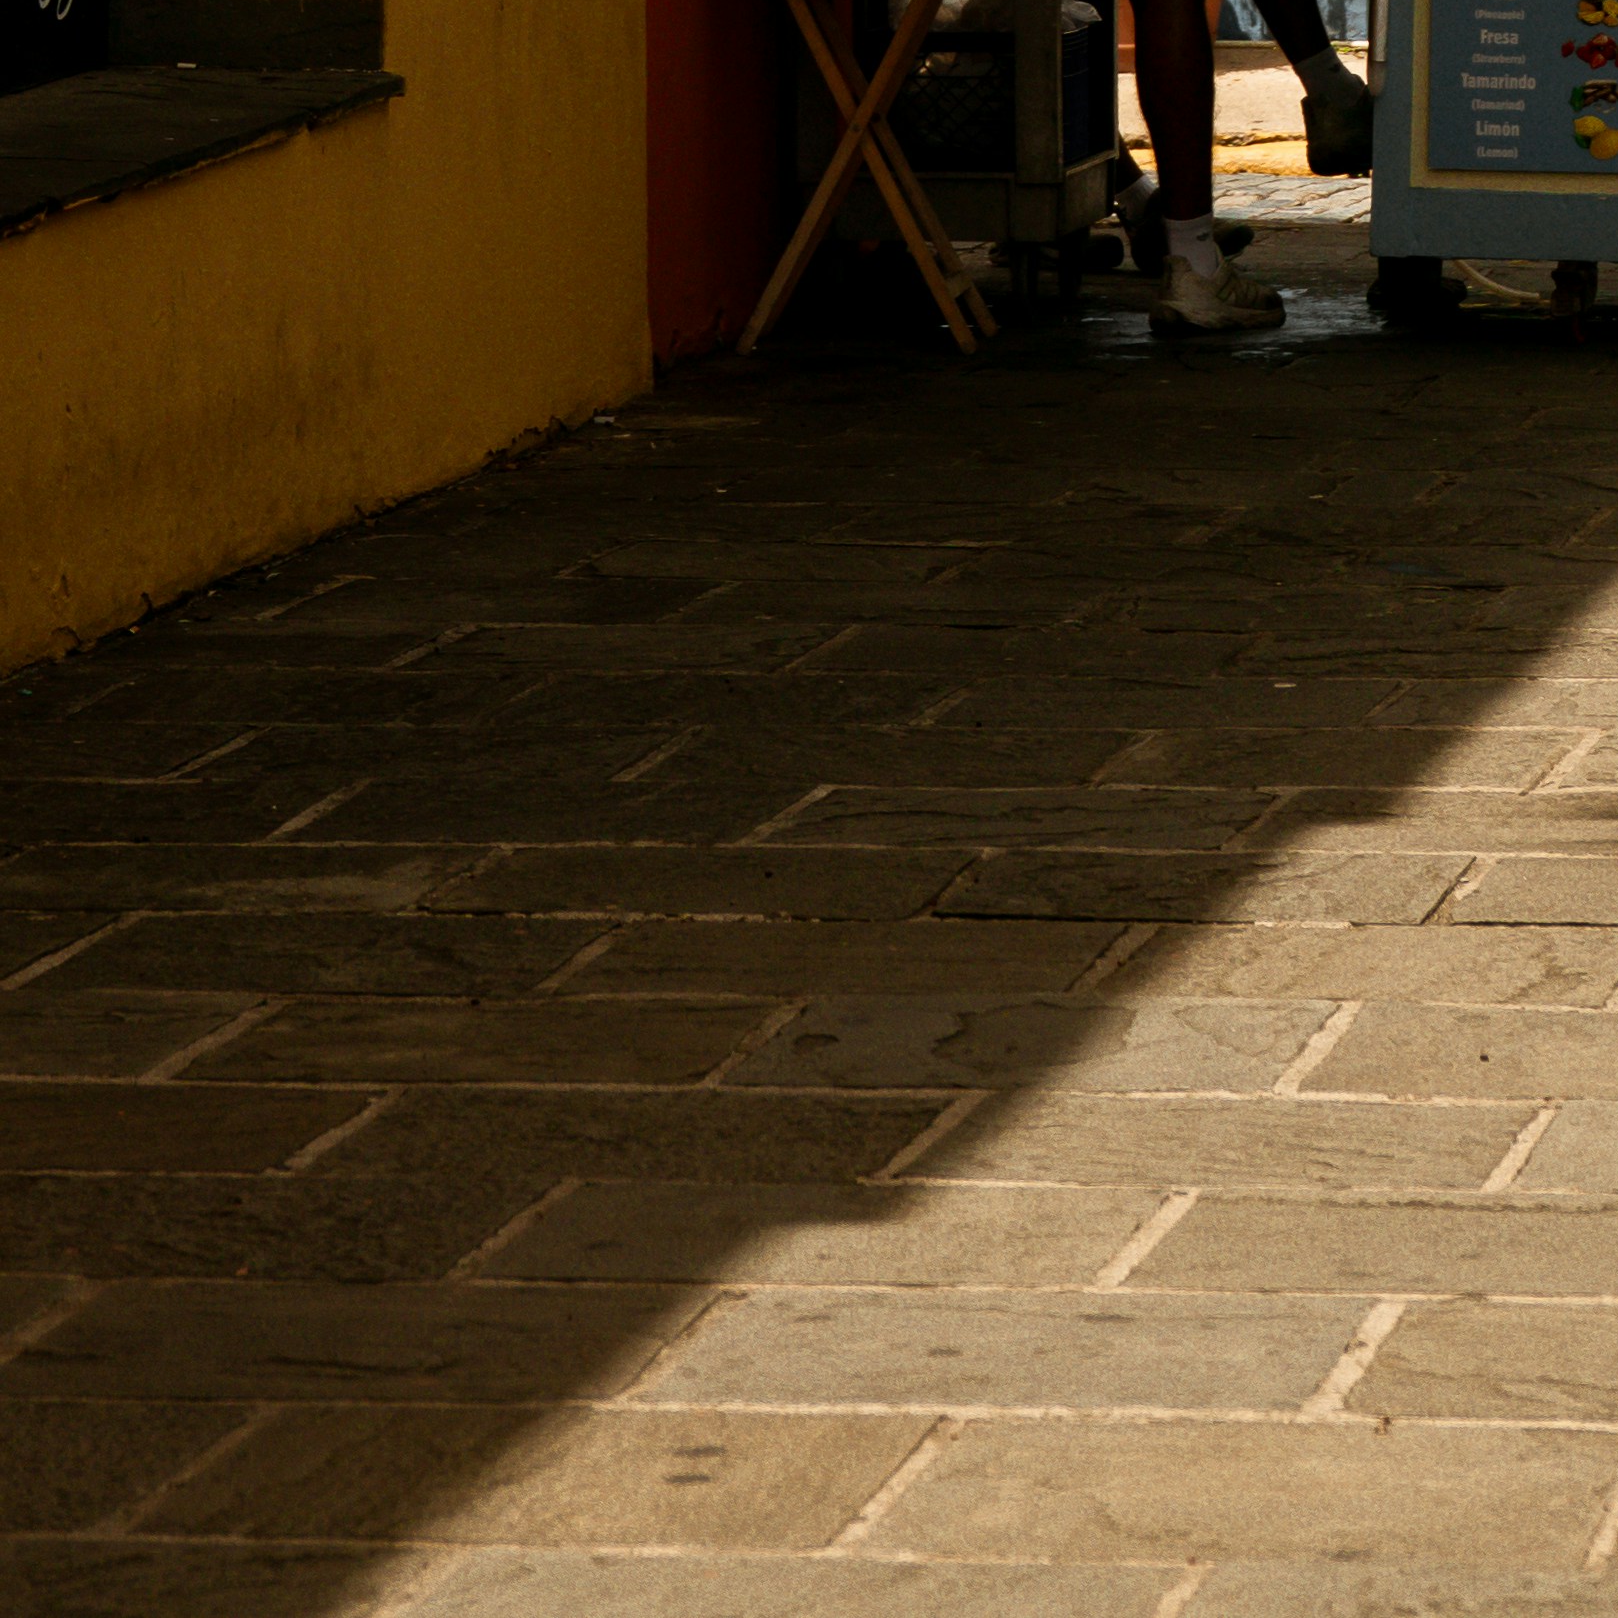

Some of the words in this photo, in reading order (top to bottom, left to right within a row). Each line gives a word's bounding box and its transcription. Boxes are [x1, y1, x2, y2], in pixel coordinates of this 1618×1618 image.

[1481, 29, 1518, 44] Fresa
[1461, 73, 1536, 89] Tamarindo
[1472, 99, 1525, 111] (Tamarind)
[1476, 121, 1519, 136] Limón
[1477, 147, 1518, 158] (Lemon)
